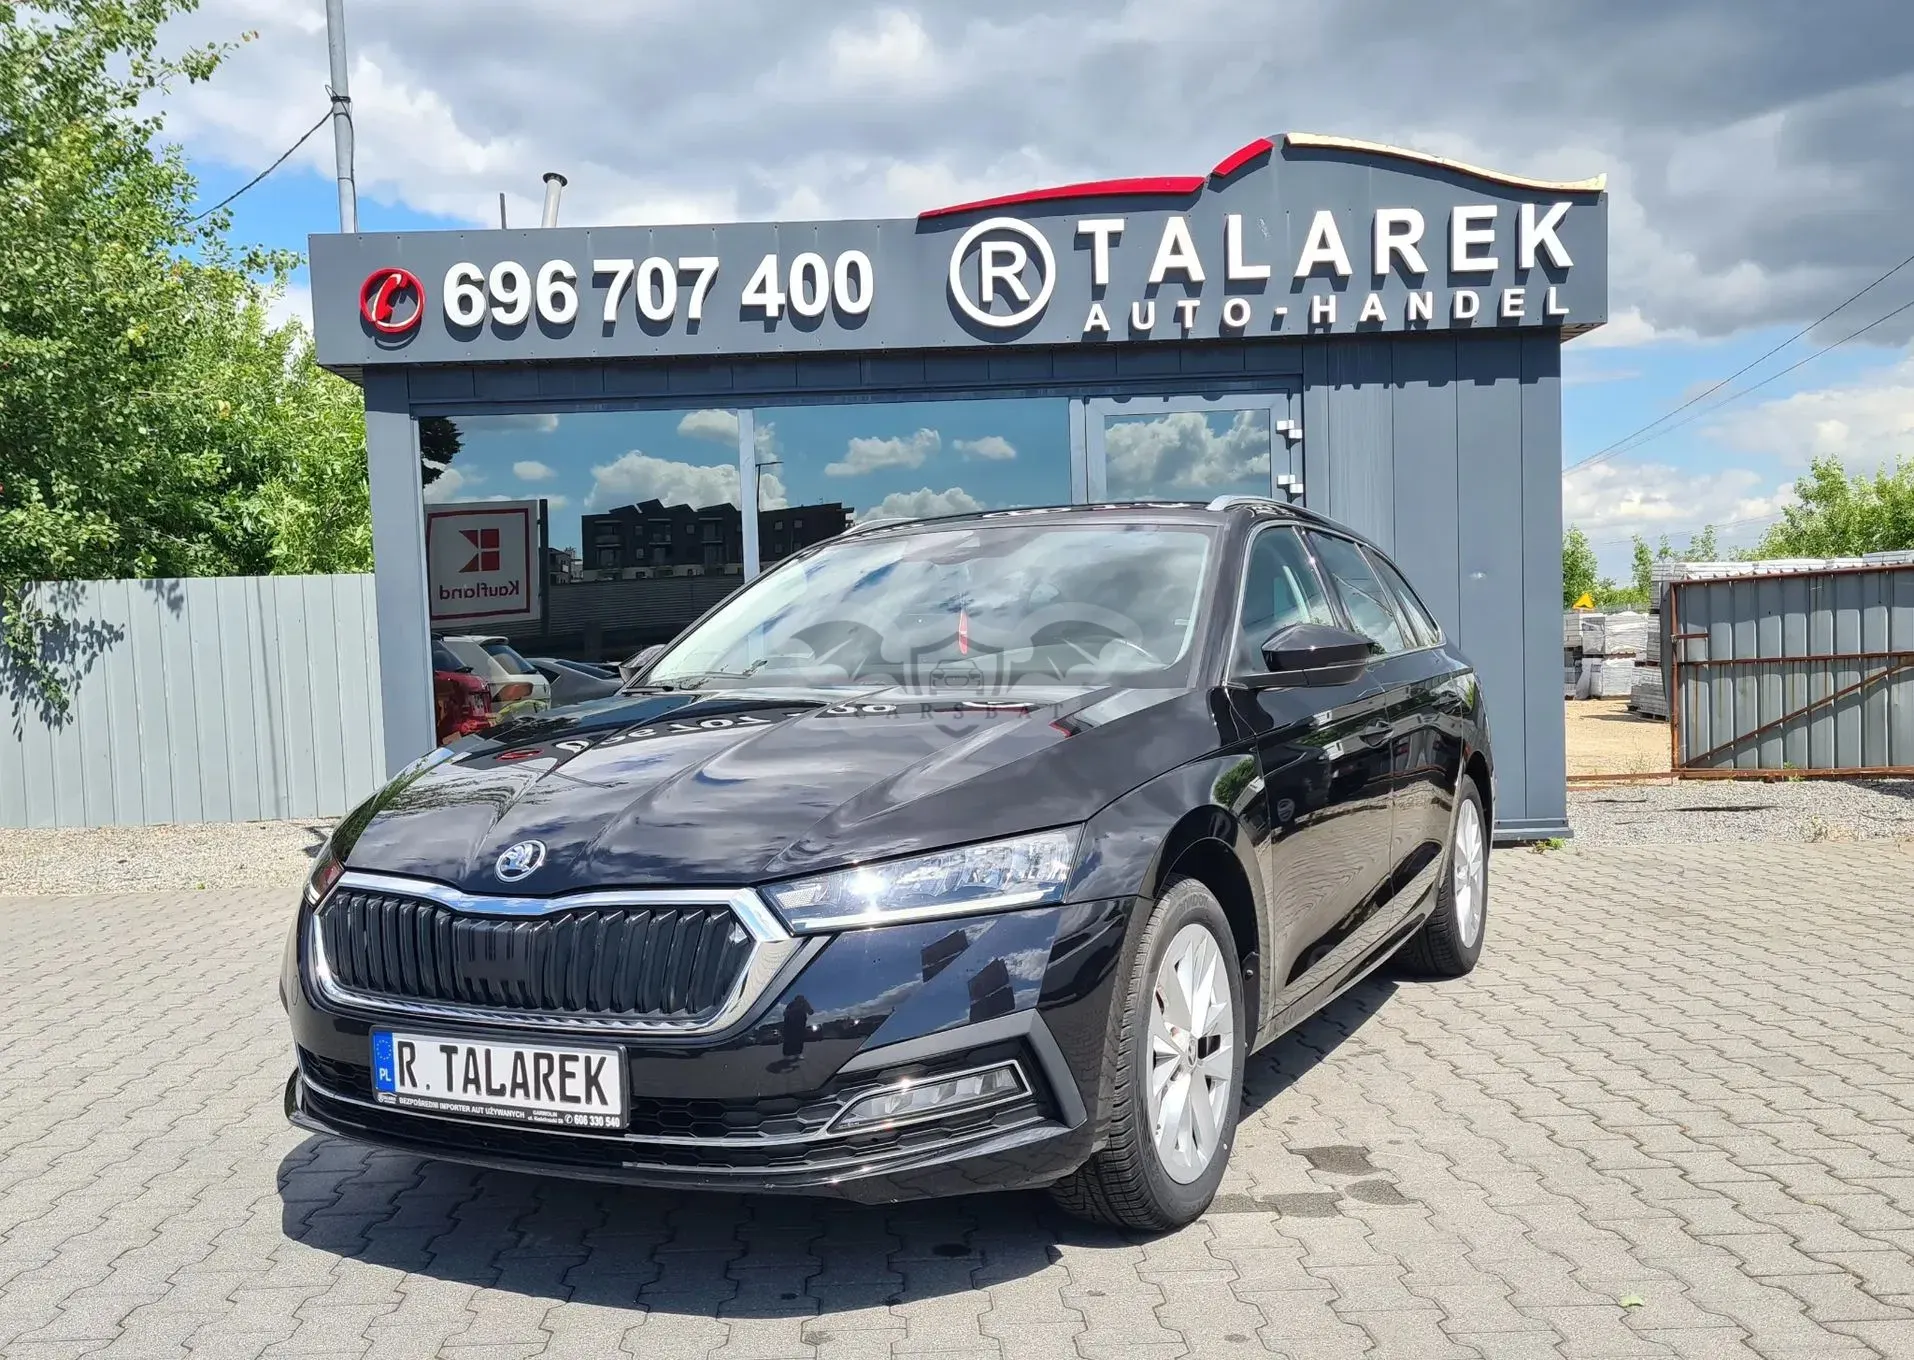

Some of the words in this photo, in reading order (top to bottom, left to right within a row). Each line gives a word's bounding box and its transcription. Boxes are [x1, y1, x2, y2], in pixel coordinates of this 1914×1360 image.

[1077, 201, 1574, 286] TALAREK
[443, 260, 578, 327] 696
[593, 256, 719, 322] 707
[740, 250, 874, 317] 400
[1084, 286, 1570, 332] AUTO-HANDEL
[379, 1067, 392, 1082] PL
[397, 1040, 431, 1091] R.
[439, 1044, 609, 1106] TALAREK
[440, 1102, 471, 1113] IMPORTER
[471, 1106, 484, 1114] AUT
[589, 1115, 604, 1127] 330
[605, 1116, 620, 1128] 540
